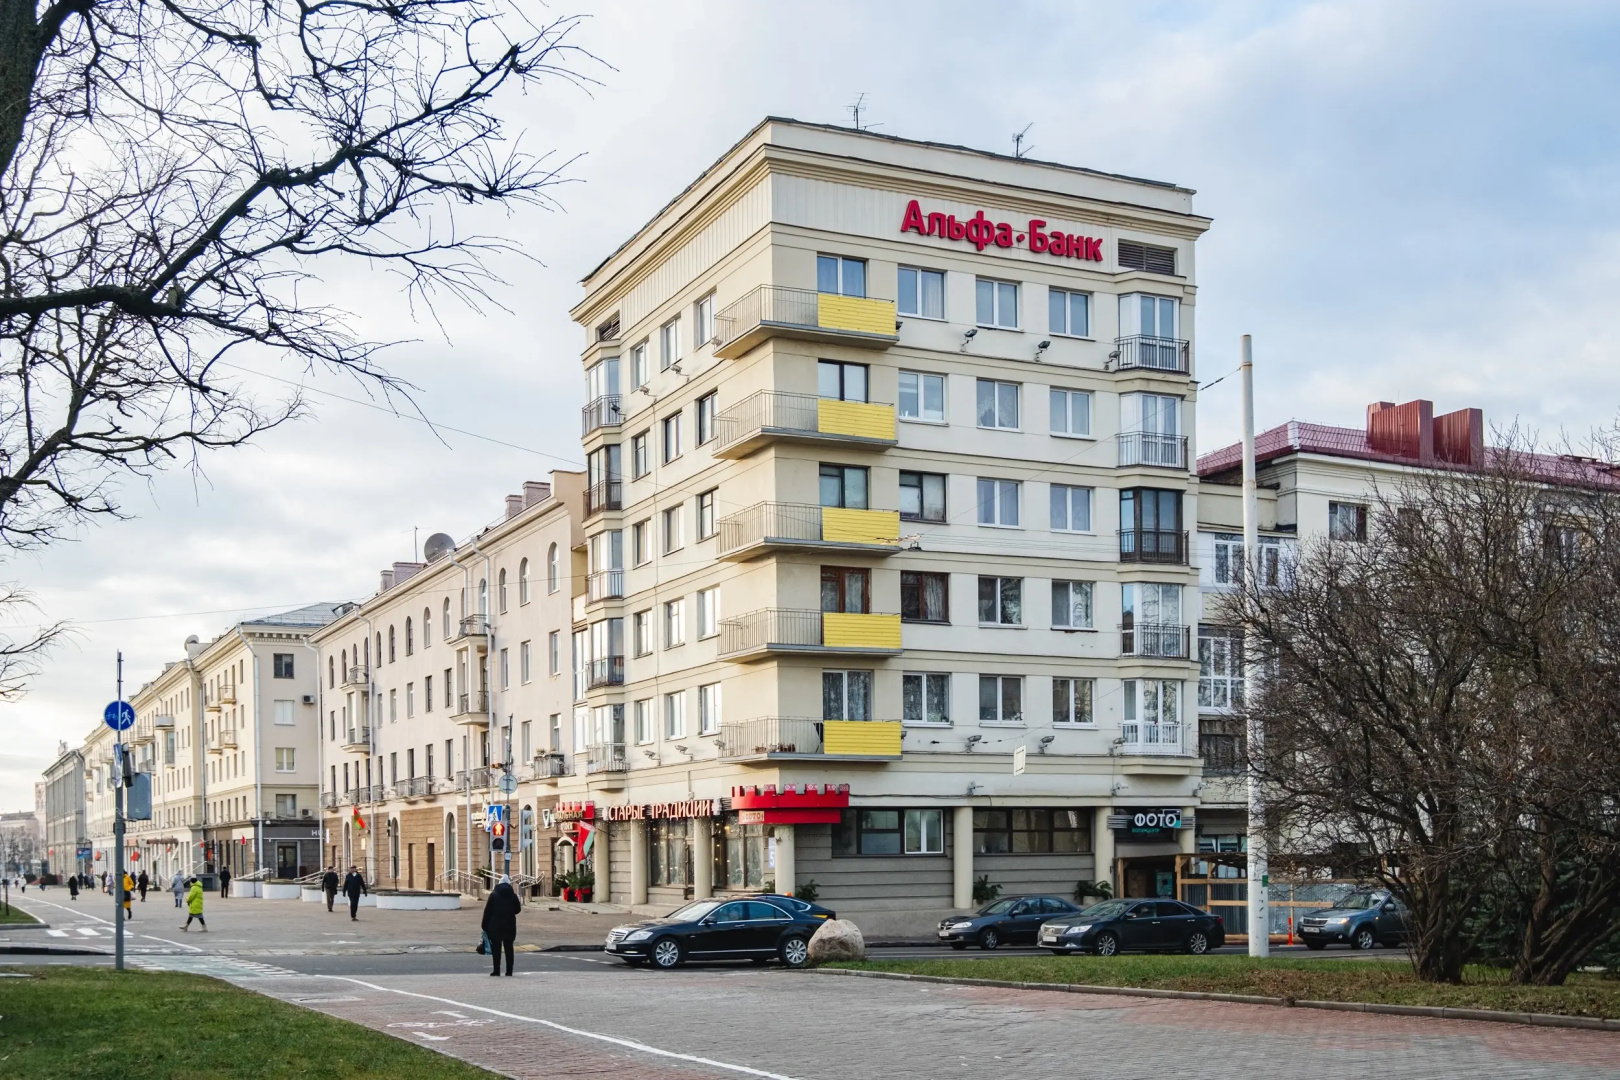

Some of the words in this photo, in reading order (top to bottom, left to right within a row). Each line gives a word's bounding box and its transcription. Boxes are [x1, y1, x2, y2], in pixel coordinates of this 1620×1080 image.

[608, 804, 645, 821] СТАРЫЕ
[650, 799, 711, 821] ТРАДИЦИИ
[1134, 813, 1177, 827] ФОТО
